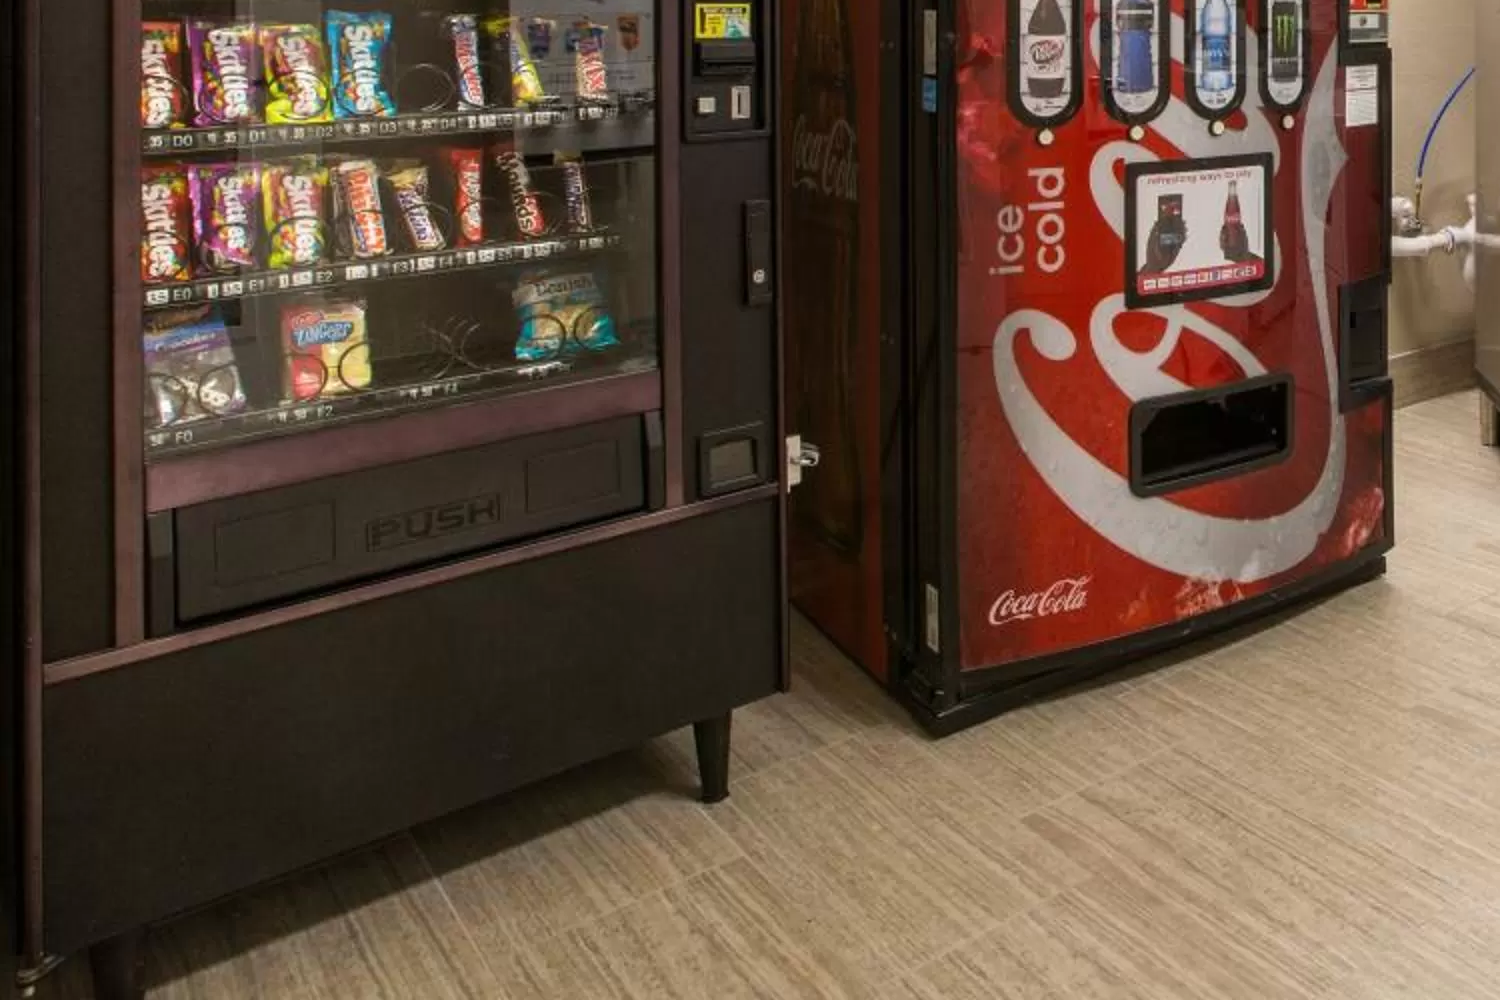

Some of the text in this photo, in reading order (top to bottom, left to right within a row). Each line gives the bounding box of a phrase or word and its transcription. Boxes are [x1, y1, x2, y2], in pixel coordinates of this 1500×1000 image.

[343, 24, 379, 113] Skittles
[173, 134, 194, 148] D0
[988, 203, 1025, 276] ice
[1028, 166, 1066, 274] cold
[370, 498, 495, 550] PUSH
[987, 574, 1094, 625] Coca-Cola
